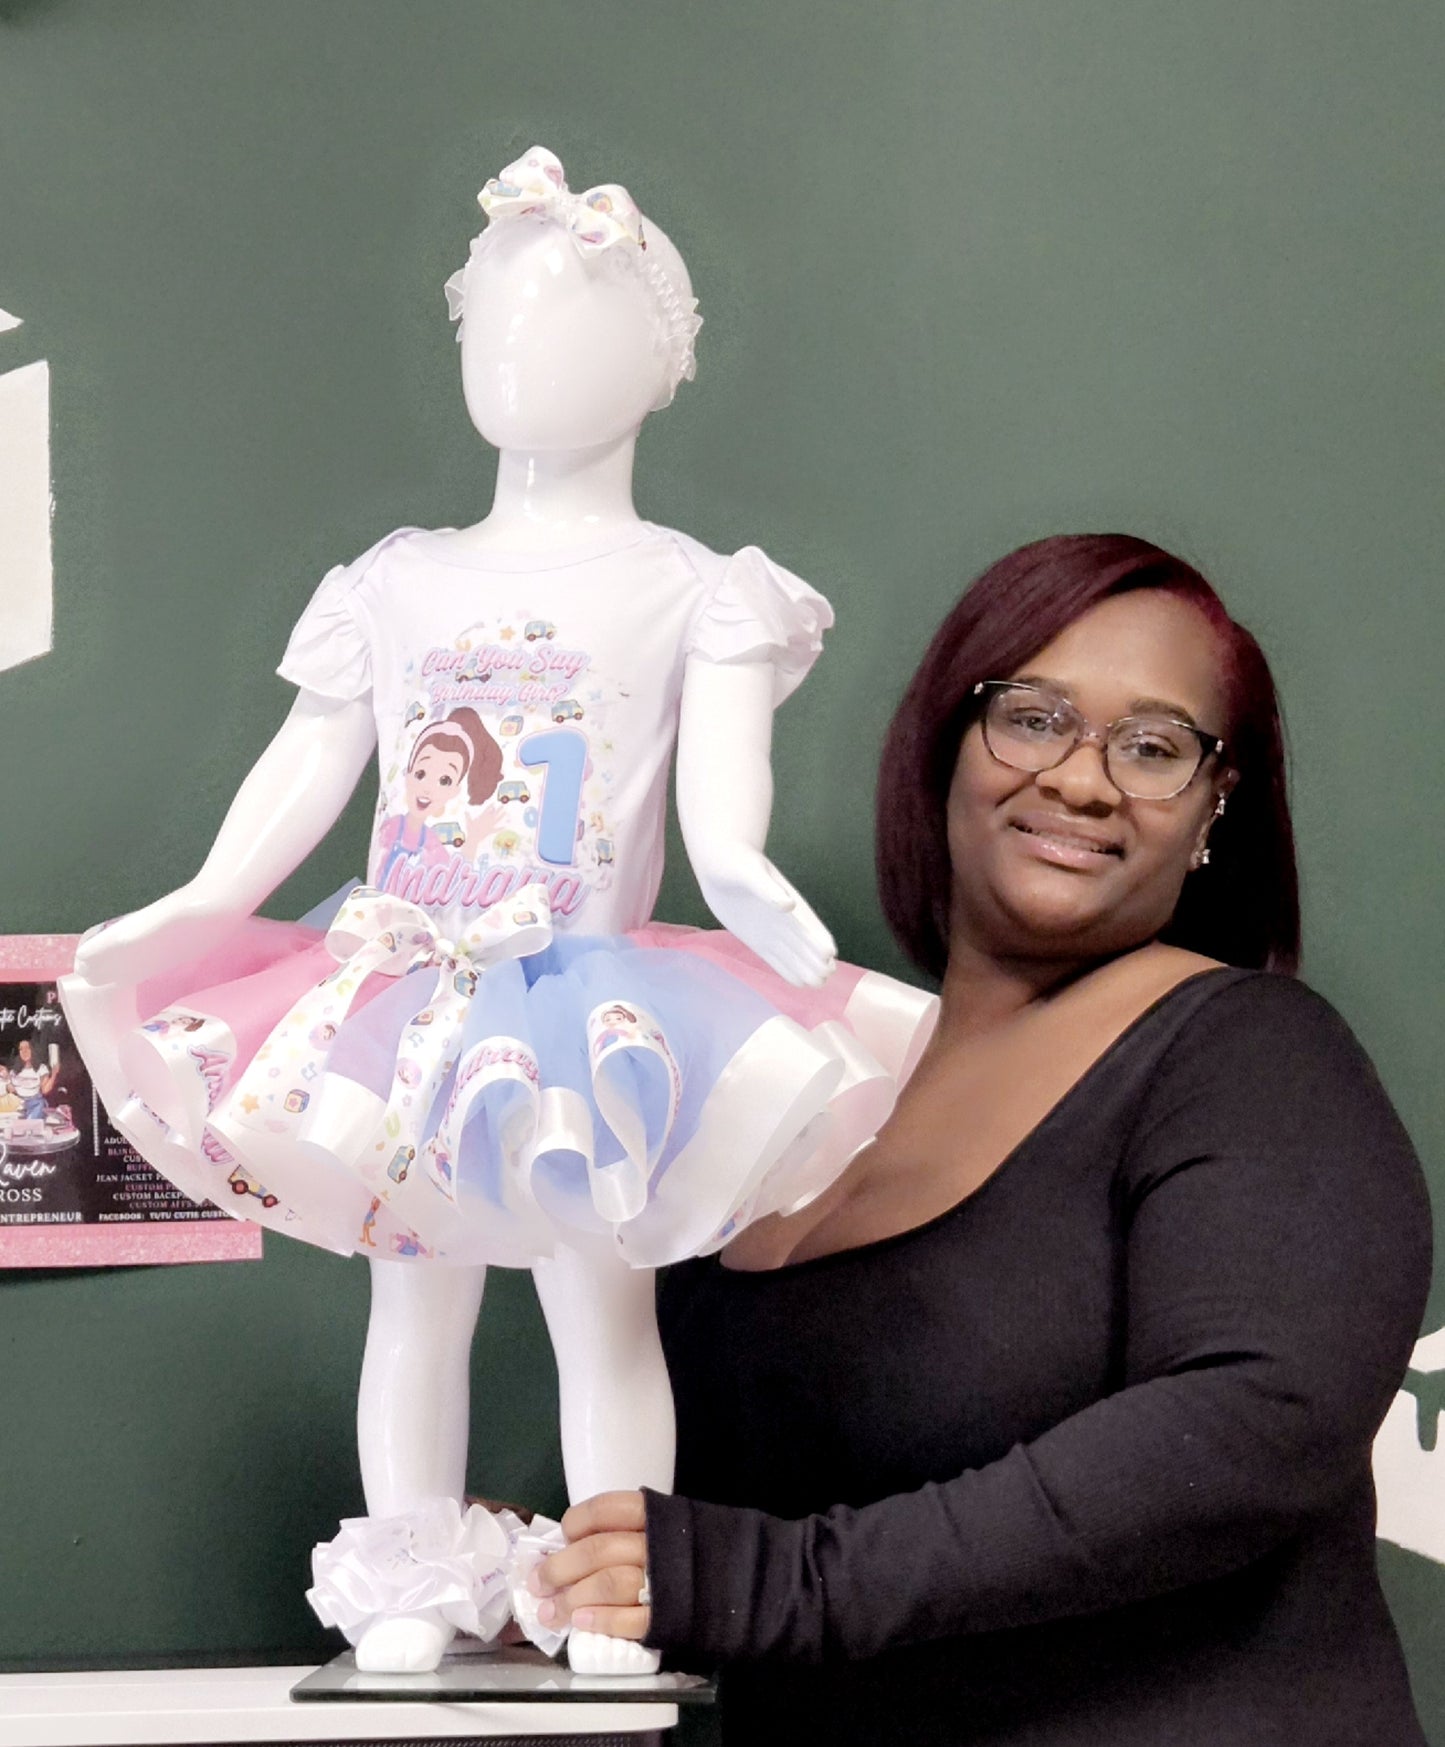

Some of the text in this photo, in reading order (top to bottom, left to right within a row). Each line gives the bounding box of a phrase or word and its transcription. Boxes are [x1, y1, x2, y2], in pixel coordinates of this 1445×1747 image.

[421, 646, 584, 680] Can You Say
[517, 728, 588, 866] 1
[120, 1173, 153, 1182] JACKET
[113, 1192, 151, 1200] CUSTOM
